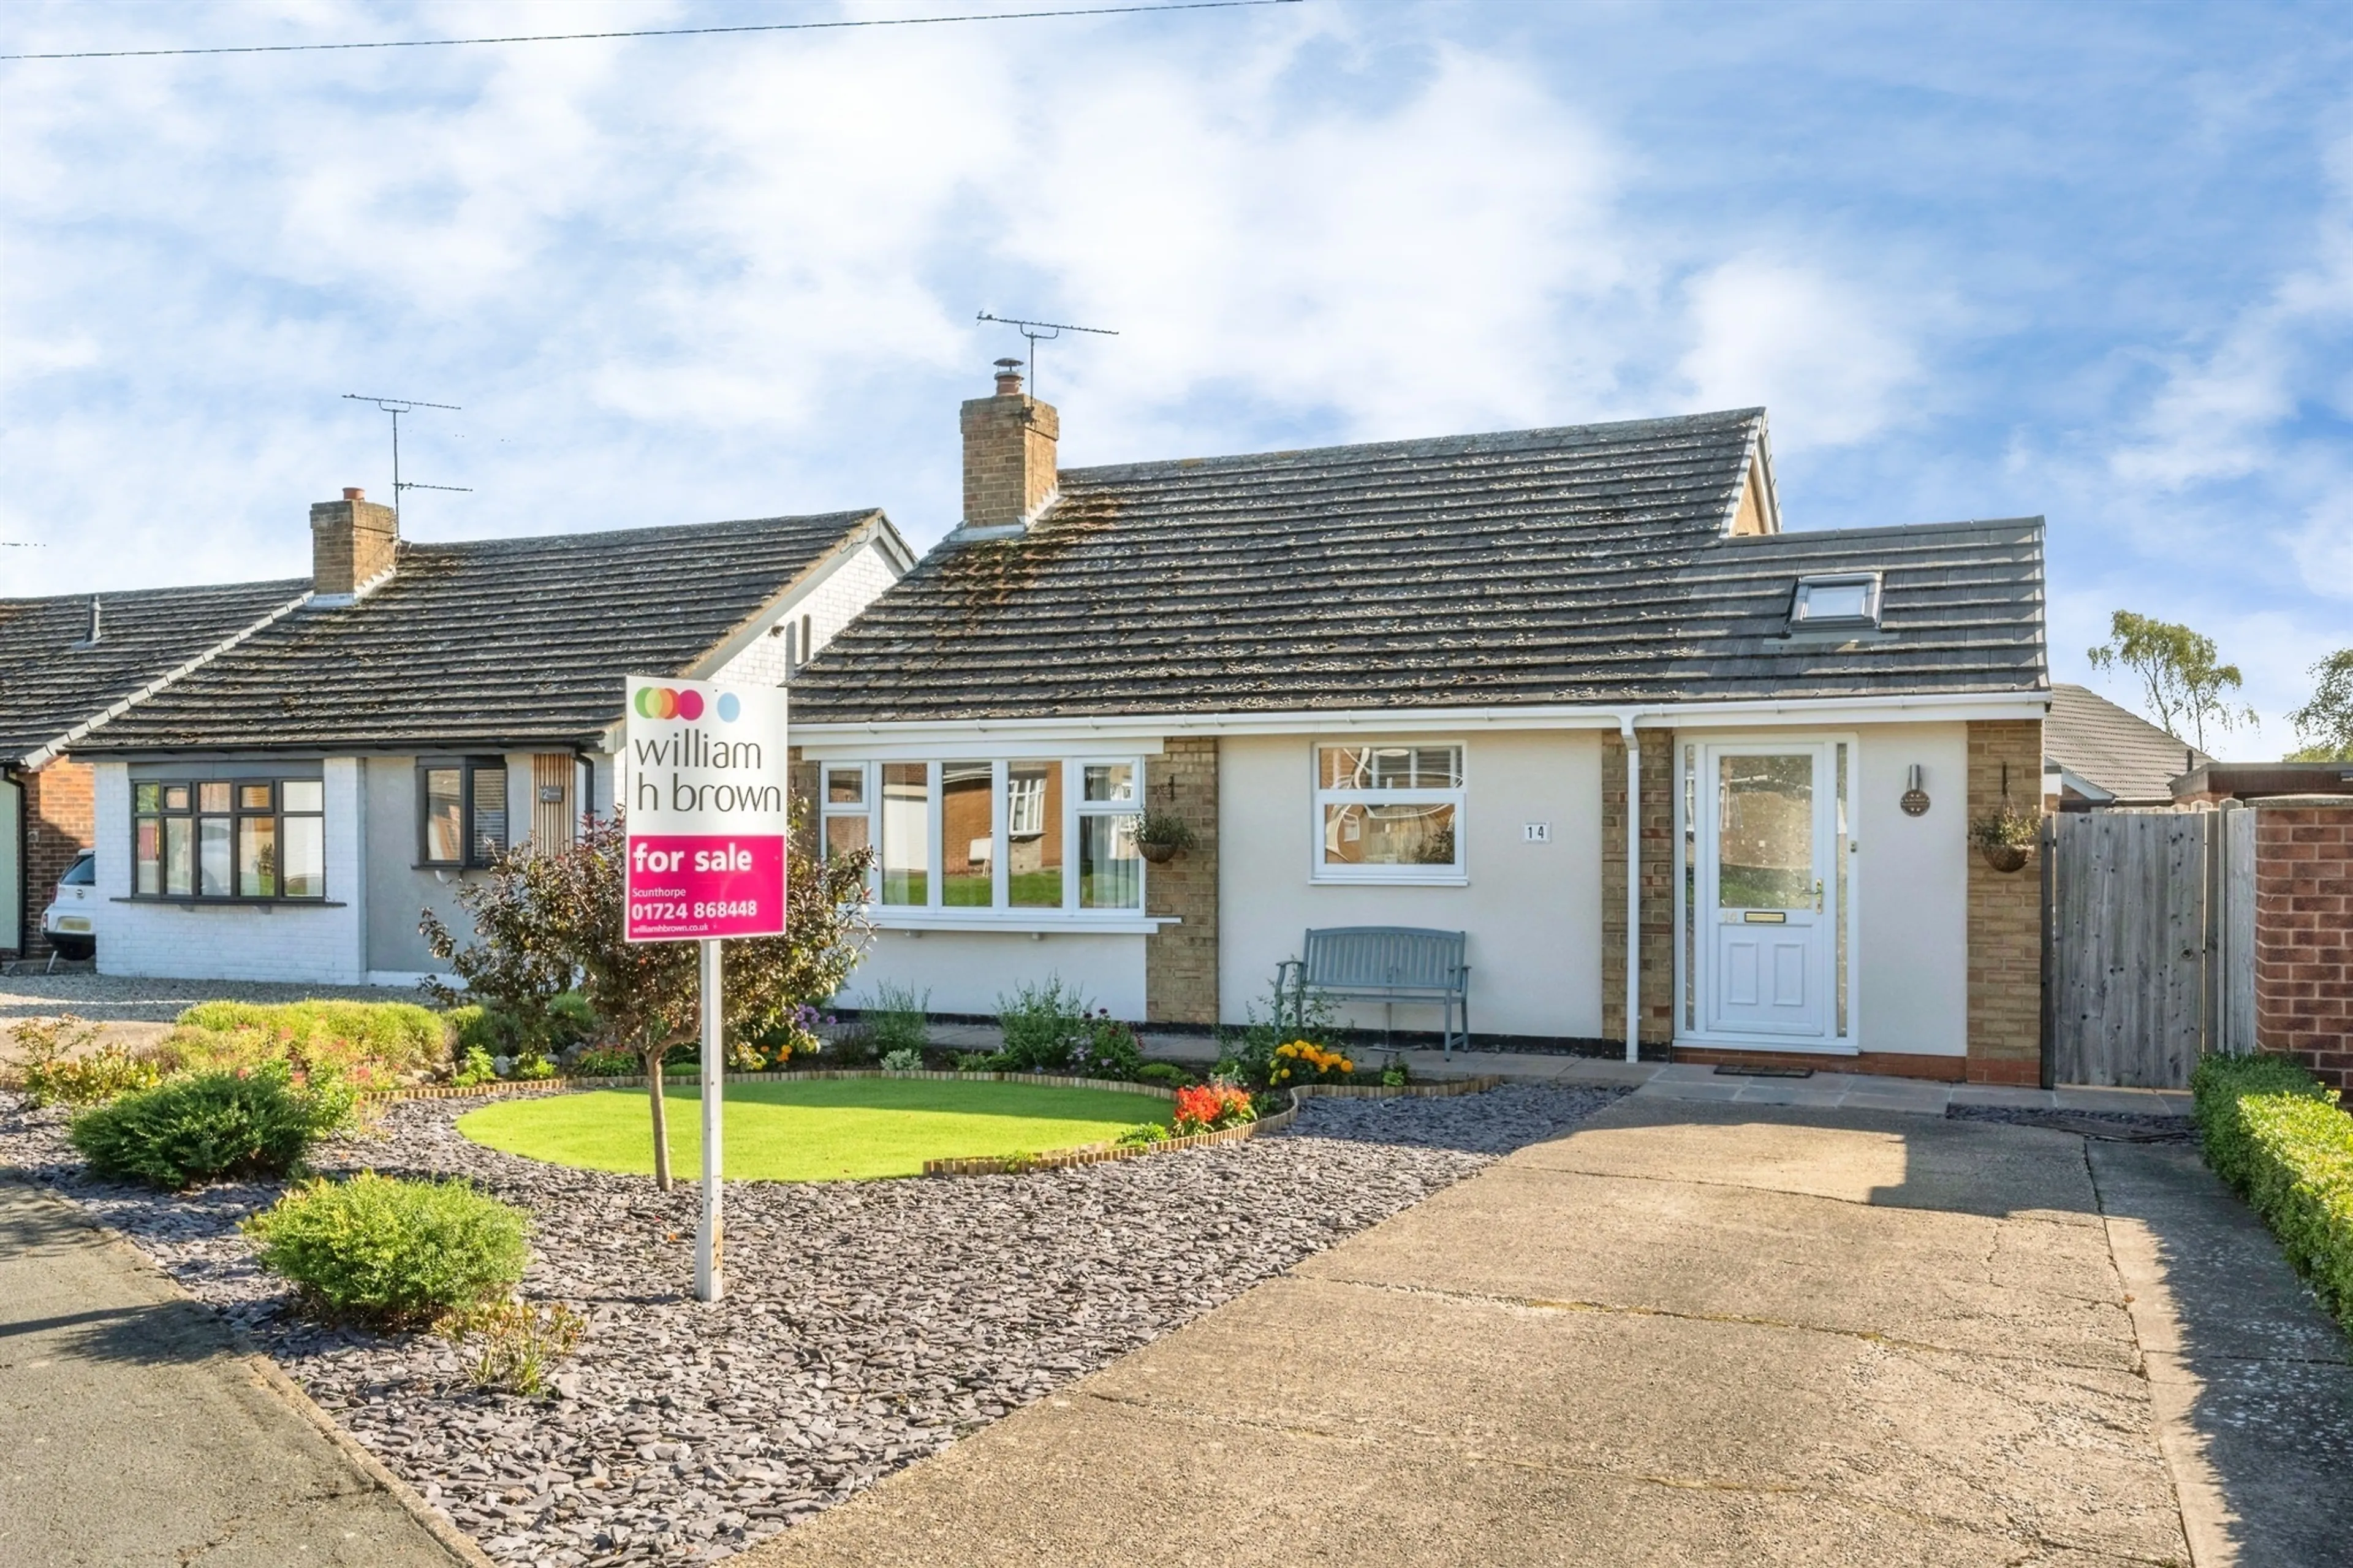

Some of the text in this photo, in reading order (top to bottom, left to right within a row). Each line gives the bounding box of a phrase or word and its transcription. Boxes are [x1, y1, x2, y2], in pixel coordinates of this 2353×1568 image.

[635, 728, 761, 769] william
[638, 772, 781, 812] h brown
[1528, 826, 1544, 839] 14
[632, 842, 752, 873] for sale
[632, 887, 686, 899] Scunthorpe
[632, 900, 757, 921] 01724 868448
[632, 923, 708, 933] williamhbrown.co.uk
